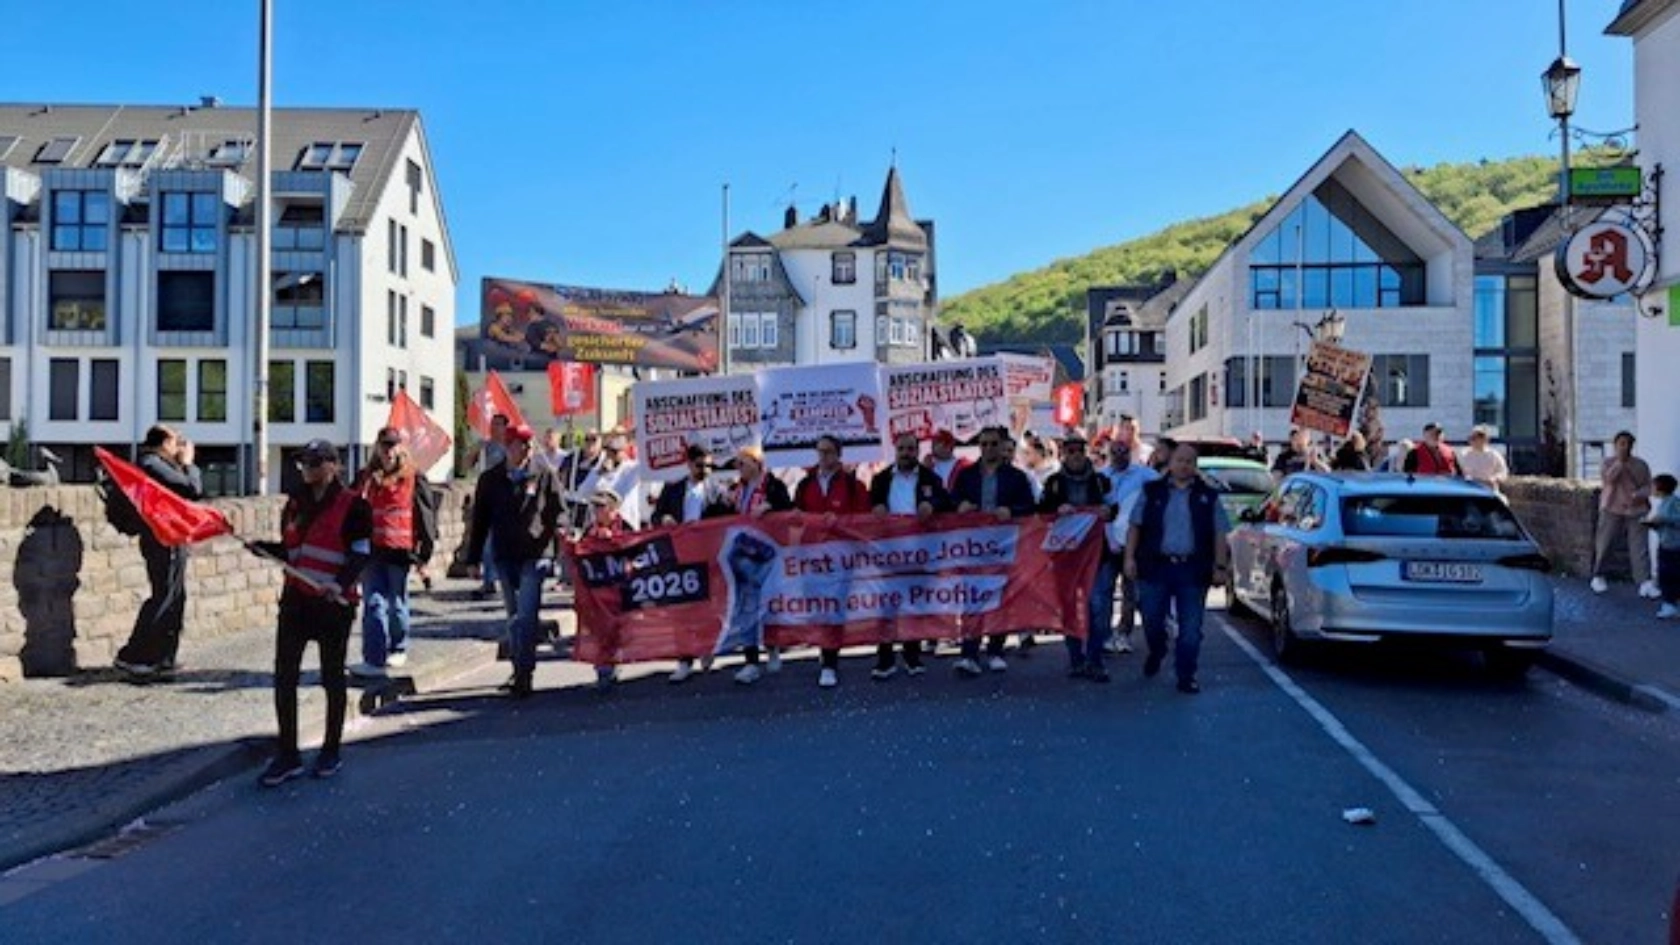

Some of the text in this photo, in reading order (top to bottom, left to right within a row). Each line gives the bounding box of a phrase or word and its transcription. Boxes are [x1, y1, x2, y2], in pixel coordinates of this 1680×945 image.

[889, 368, 974, 387] ABSCHAFFUNG
[977, 365, 999, 380] DES
[645, 392, 728, 410] ABSCHAFFUNG
[784, 538, 1008, 577] Erst unsere Jobs,
[631, 569, 700, 602] 2026
[768, 582, 995, 615] dann eure Profite
